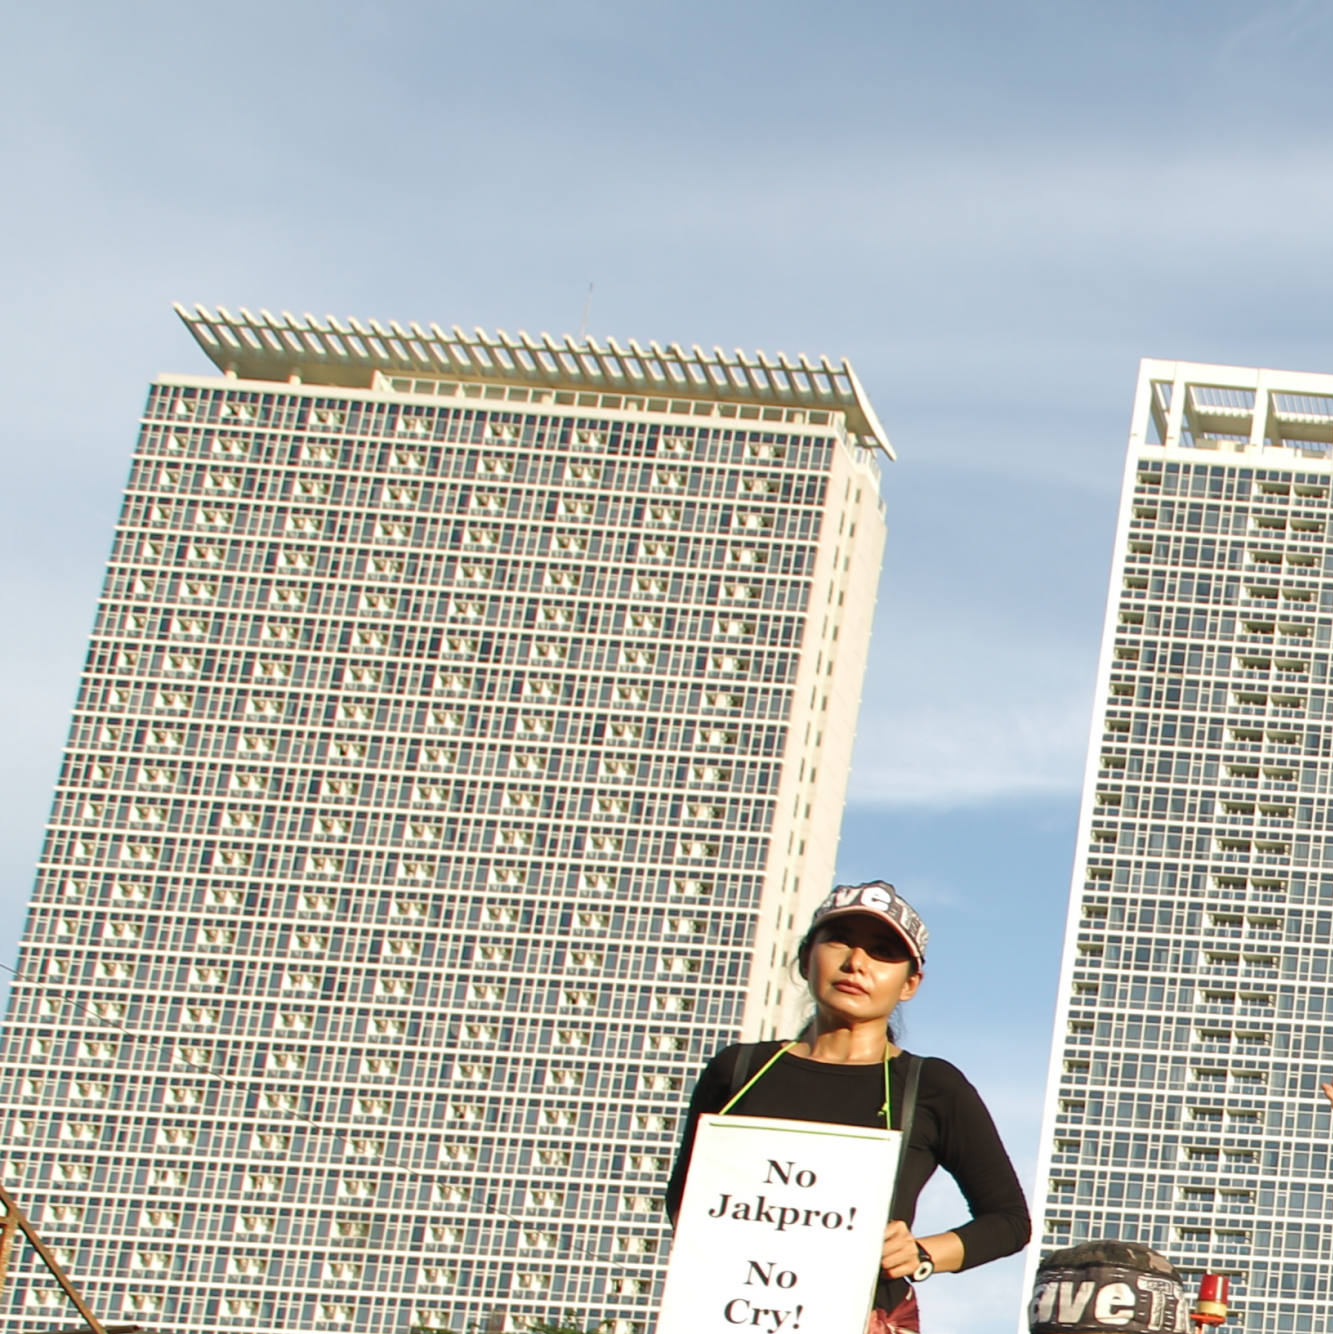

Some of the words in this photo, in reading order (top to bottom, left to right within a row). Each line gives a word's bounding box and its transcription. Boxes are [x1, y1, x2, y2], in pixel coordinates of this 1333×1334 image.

[762, 1159, 817, 1188] No
[708, 1193, 857, 1232] Jakpro!
[743, 1260, 798, 1289] No
[723, 1298, 804, 1334] Cry!
